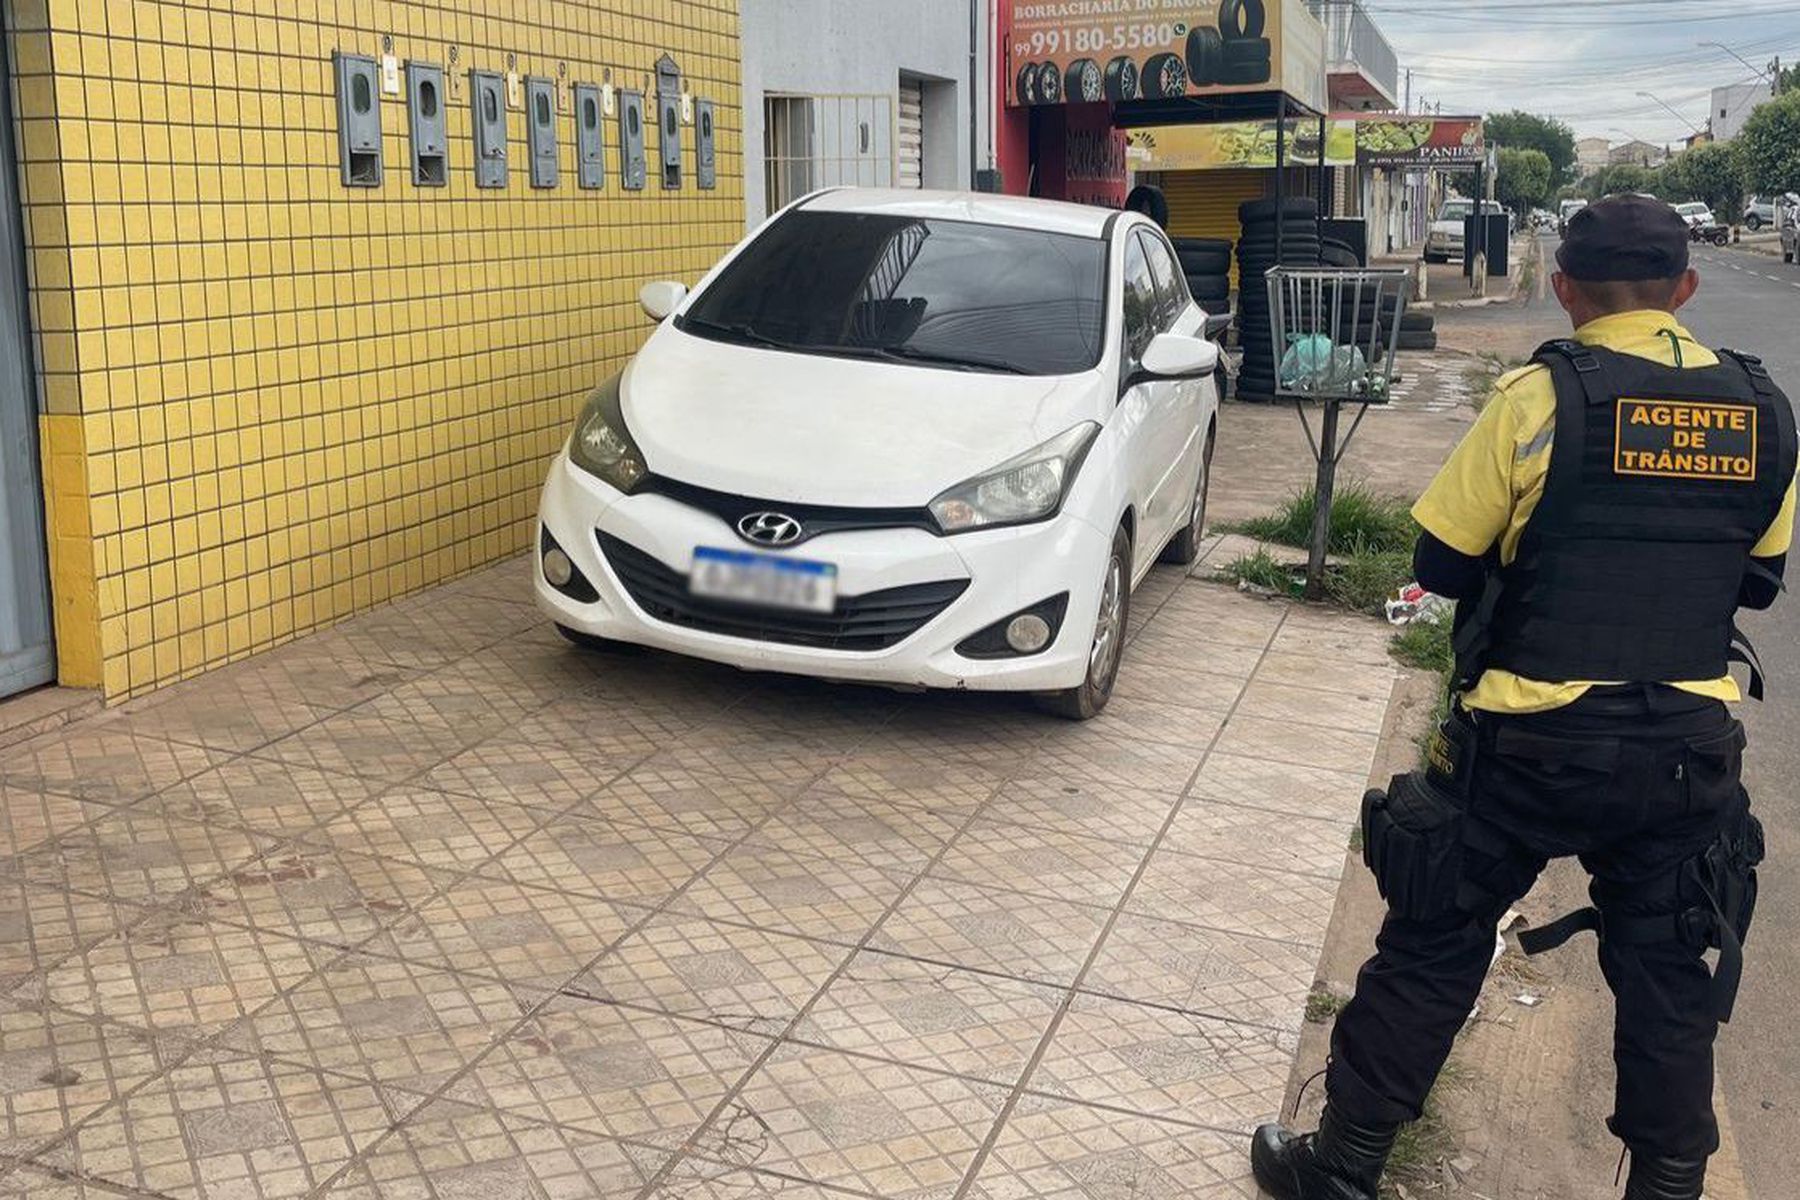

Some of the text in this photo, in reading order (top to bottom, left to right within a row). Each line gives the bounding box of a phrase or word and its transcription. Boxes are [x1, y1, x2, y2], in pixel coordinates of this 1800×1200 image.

[1014, 0, 1131, 19] BORRACHARIA
[1015, 23, 1172, 57] 99 99180-5580
[1631, 406, 1746, 430] AGENTE
[1673, 431, 1706, 448] DE
[1621, 449, 1751, 474] TRÂNSITO
